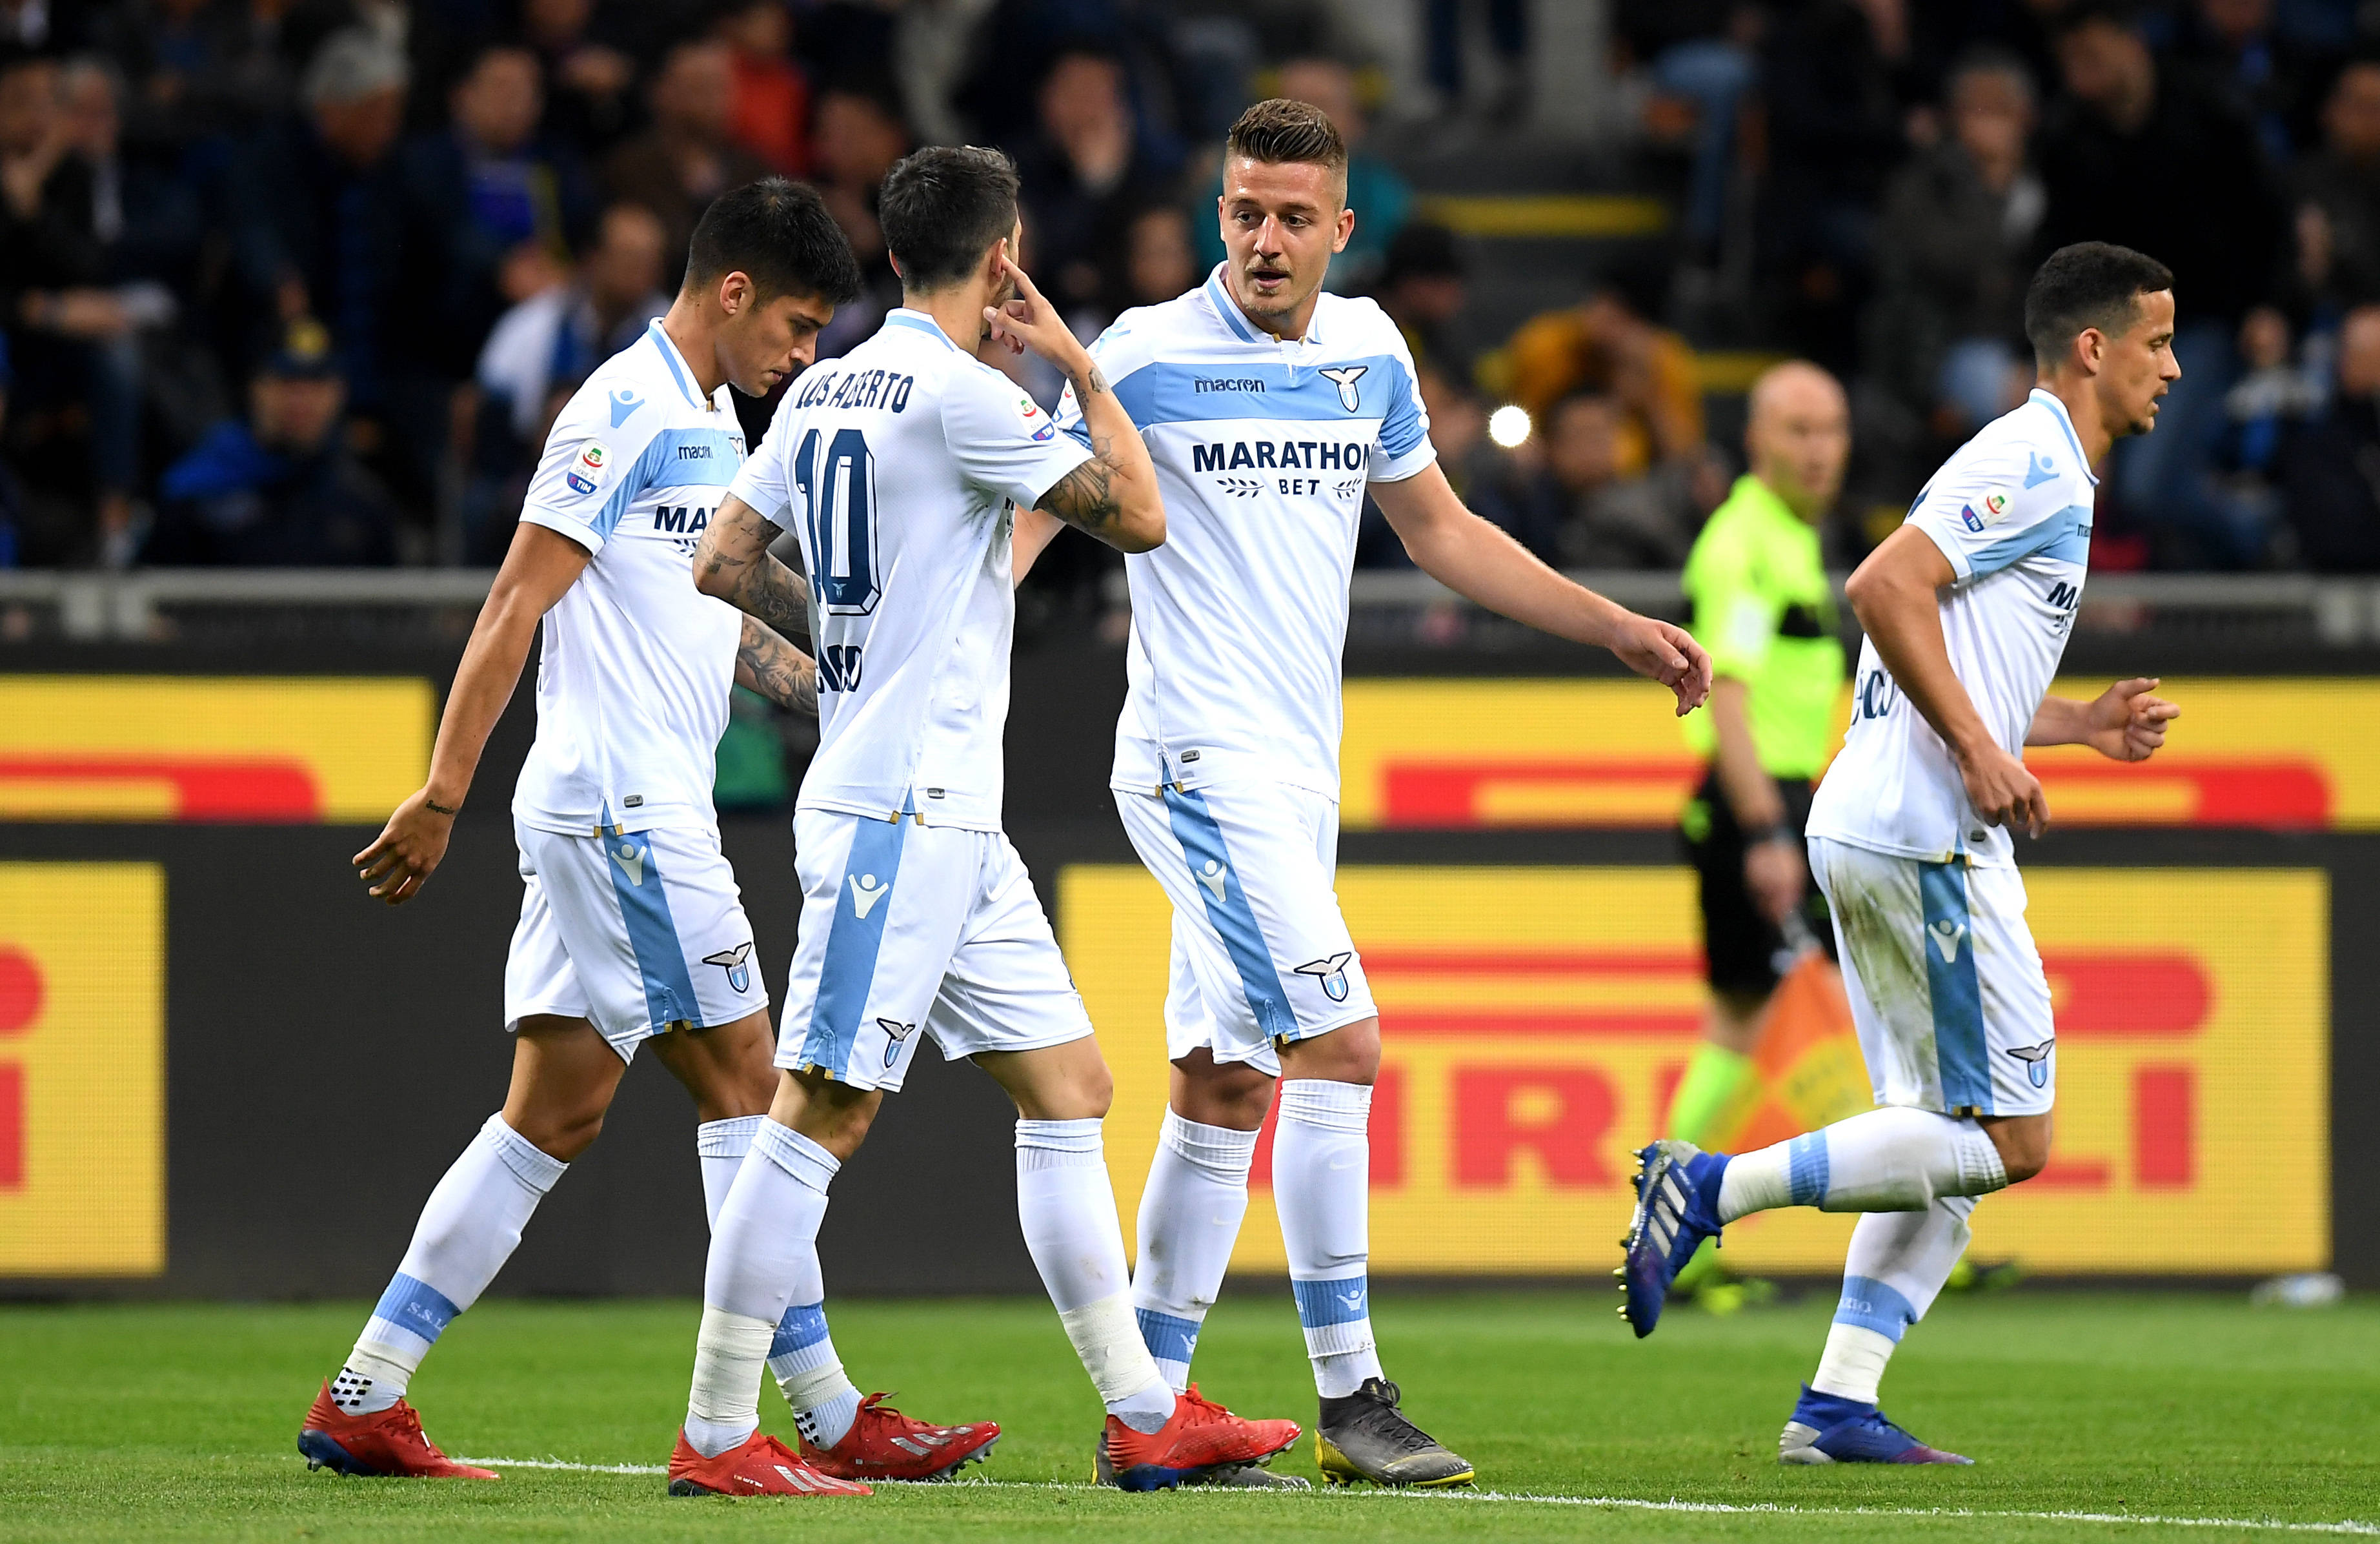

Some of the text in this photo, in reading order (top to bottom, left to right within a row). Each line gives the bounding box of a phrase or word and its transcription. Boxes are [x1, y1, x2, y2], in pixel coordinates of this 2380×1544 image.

[1194, 378, 1266, 393] macron
[576, 480, 592, 493] TIM
[1278, 479, 1320, 495] BET
[795, 429, 882, 616] 10
